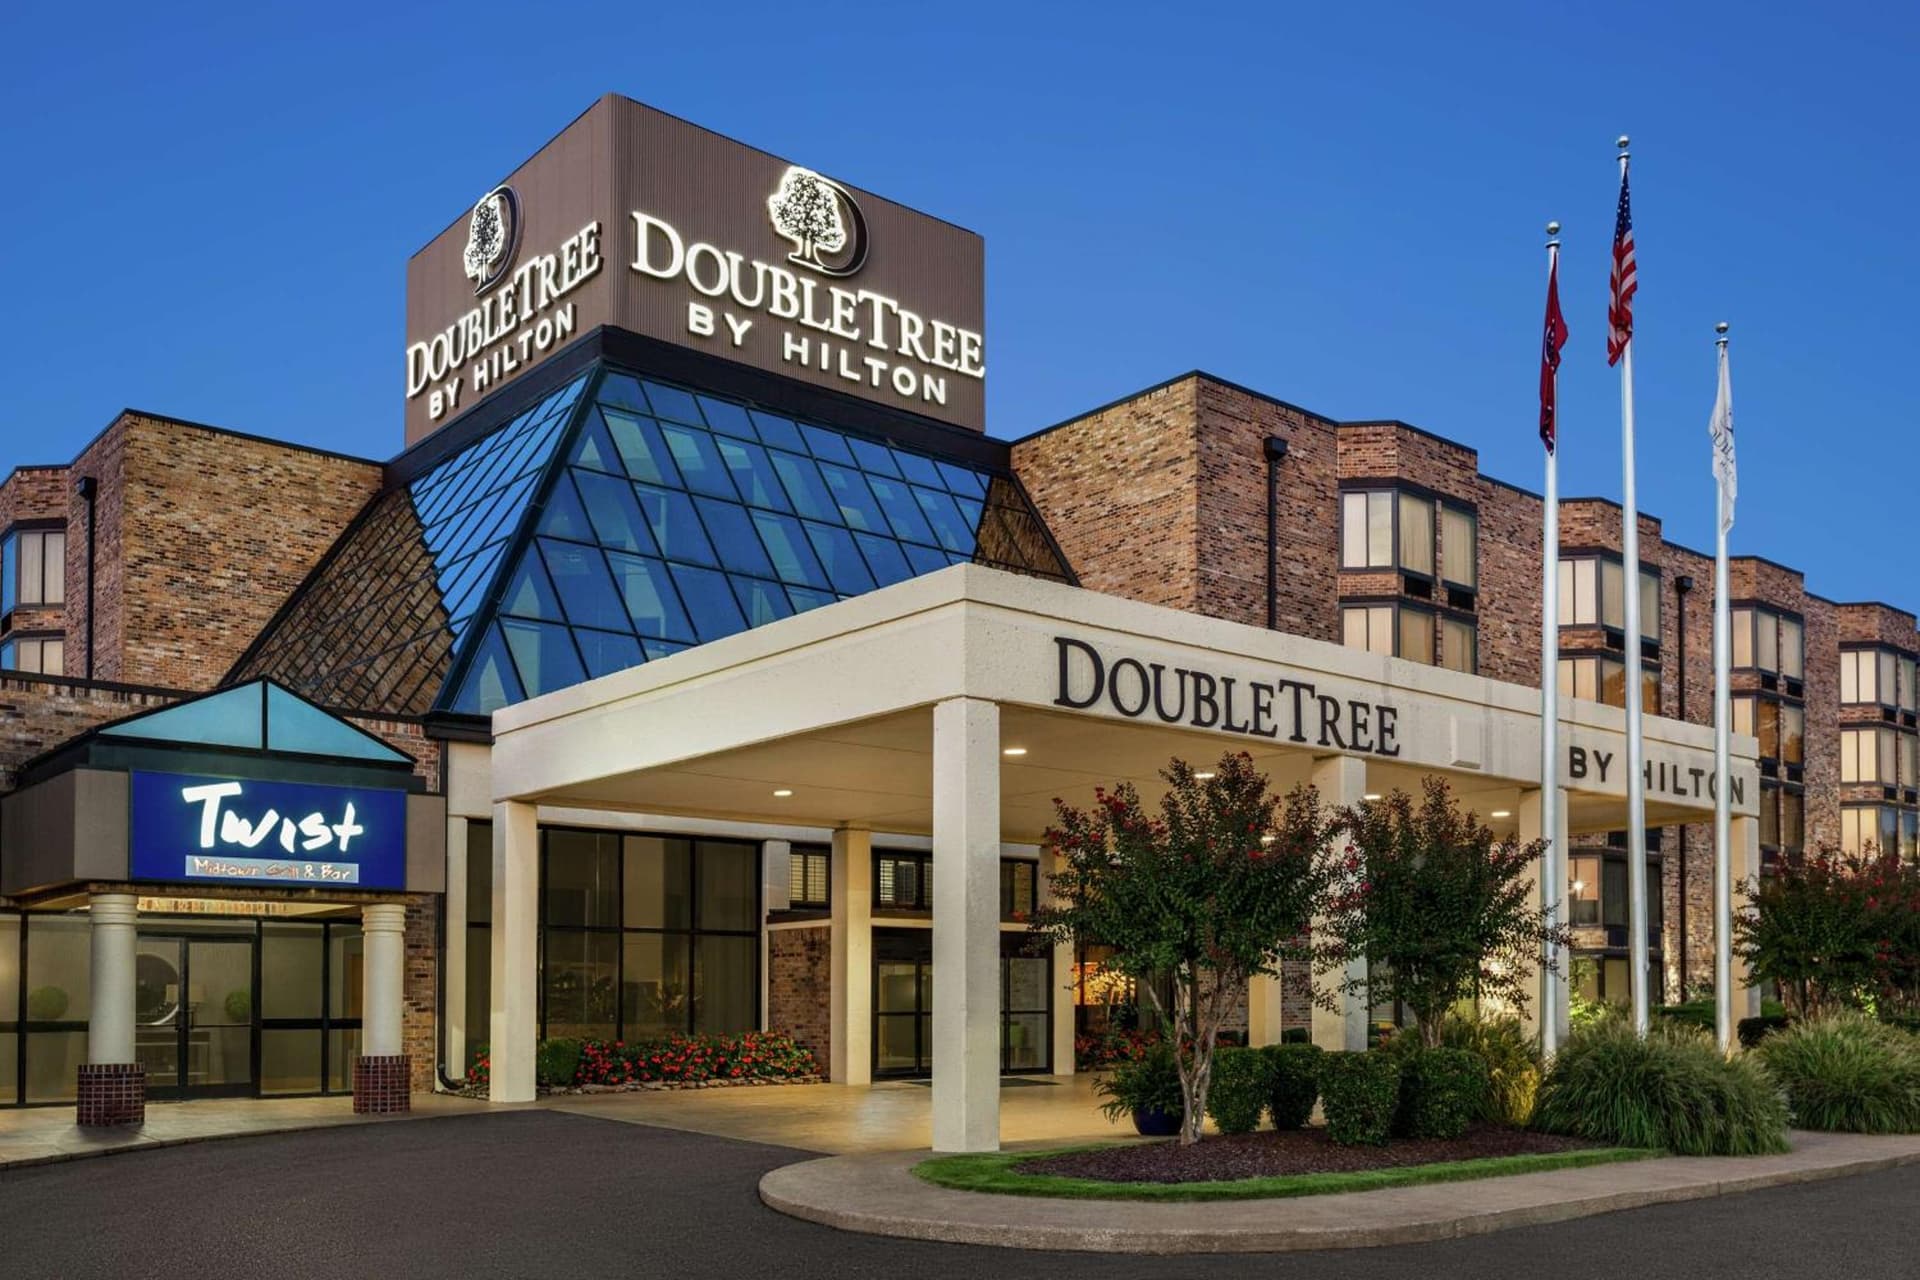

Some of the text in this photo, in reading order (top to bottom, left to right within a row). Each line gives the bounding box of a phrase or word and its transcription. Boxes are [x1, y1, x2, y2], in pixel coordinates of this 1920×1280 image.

[429, 302, 576, 420] BY HILTON
[687, 302, 948, 405] BY HILTON
[1569, 745, 1614, 783] BY
[303, 863, 316, 878] &
[321, 863, 351, 881] Bar
